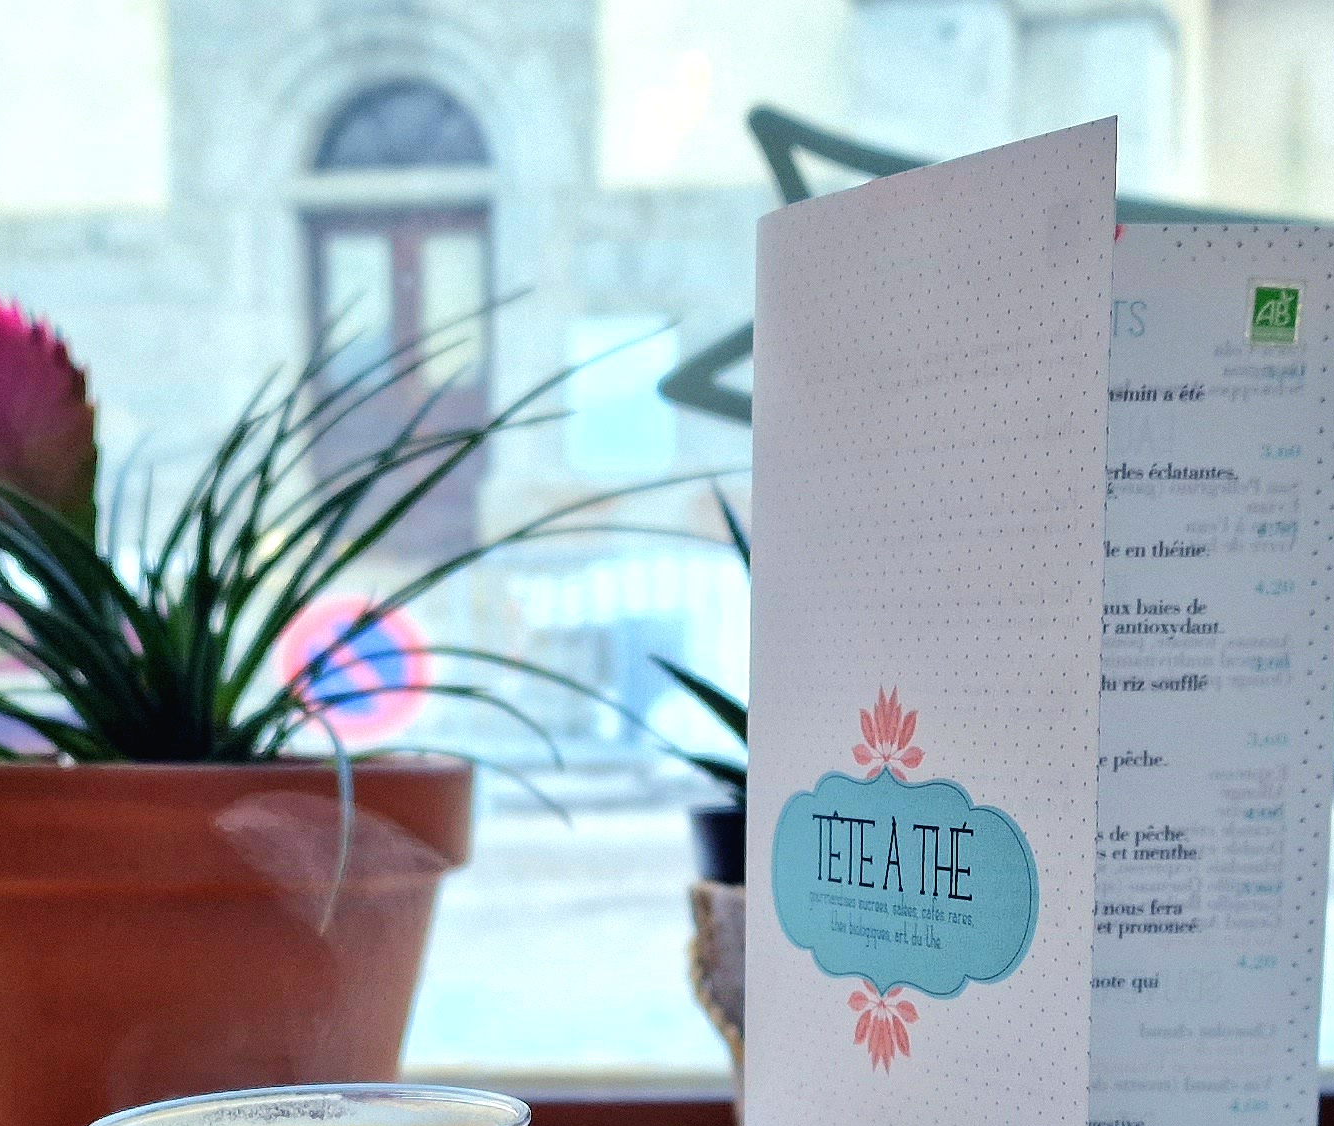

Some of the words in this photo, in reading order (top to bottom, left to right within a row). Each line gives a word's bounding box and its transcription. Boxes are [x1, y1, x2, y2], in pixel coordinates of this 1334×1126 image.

[1179, 383, 1205, 402] été
[1148, 462, 1239, 482] éclatantes,
[1125, 547, 1146, 558] en
[1151, 539, 1210, 558] théine.
[1136, 597, 1181, 616] baies
[1186, 597, 1207, 616] de
[1114, 617, 1225, 641] antioxydant.
[1122, 676, 1145, 692] riz
[1151, 674, 1208, 692] soufflé
[1113, 750, 1168, 773] pêche.
[1109, 825, 1129, 842] de
[811, 810, 876, 889] TÊTE
[912, 821, 975, 901] THÉ
[1112, 848, 1128, 860] et
[1133, 844, 1202, 861] menthe.
[1103, 904, 1145, 916] nous
[1150, 898, 1183, 916] fera
[1096, 921, 1113, 934] et
[1131, 972, 1159, 994] qui
